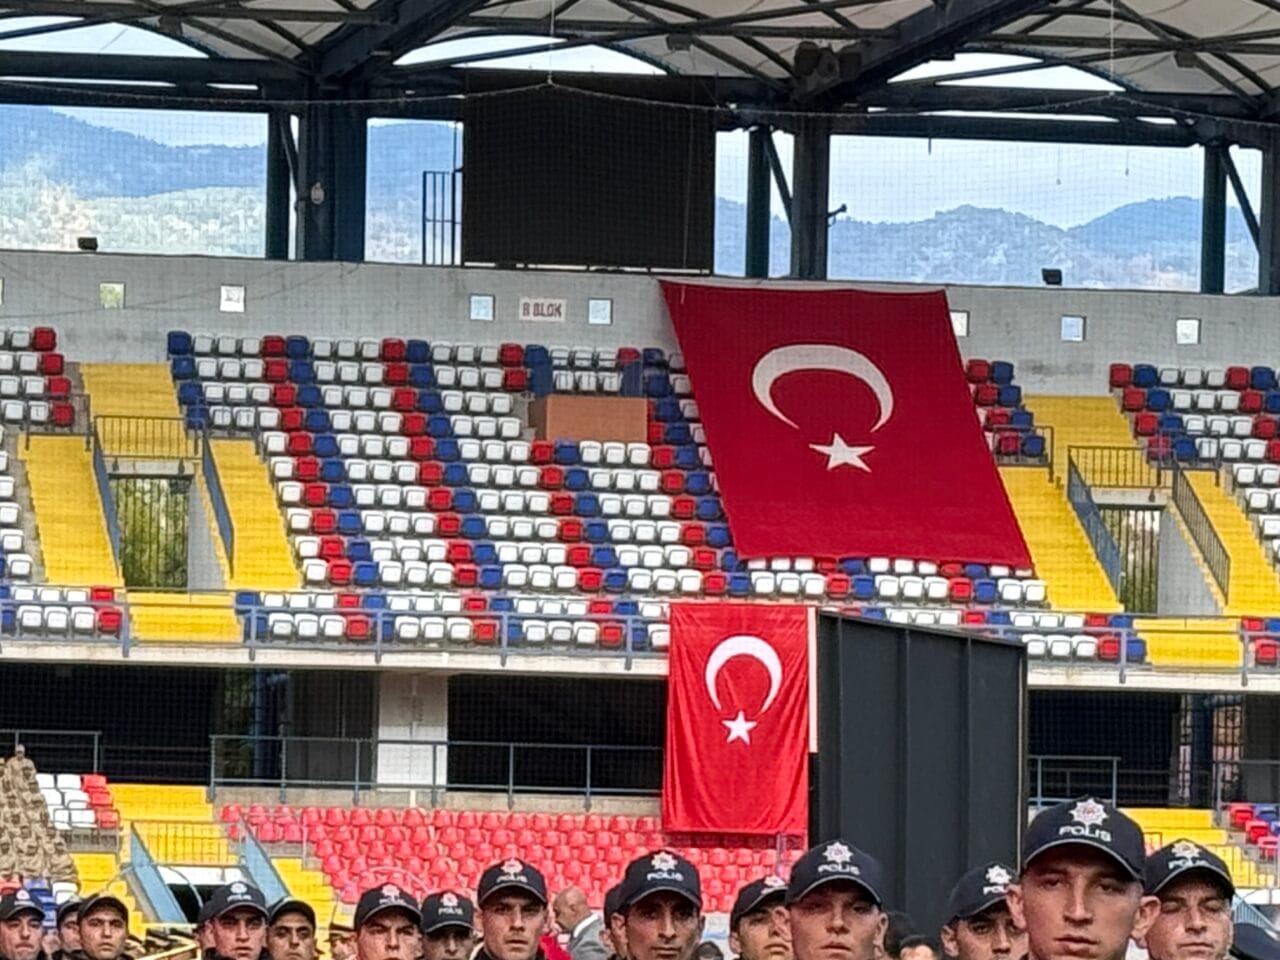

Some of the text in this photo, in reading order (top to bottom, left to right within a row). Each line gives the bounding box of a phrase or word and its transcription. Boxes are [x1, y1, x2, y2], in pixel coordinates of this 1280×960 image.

[1058, 825, 1113, 842] POLIS
[817, 863, 861, 876] POLIS
[646, 871, 685, 882] POLIS
